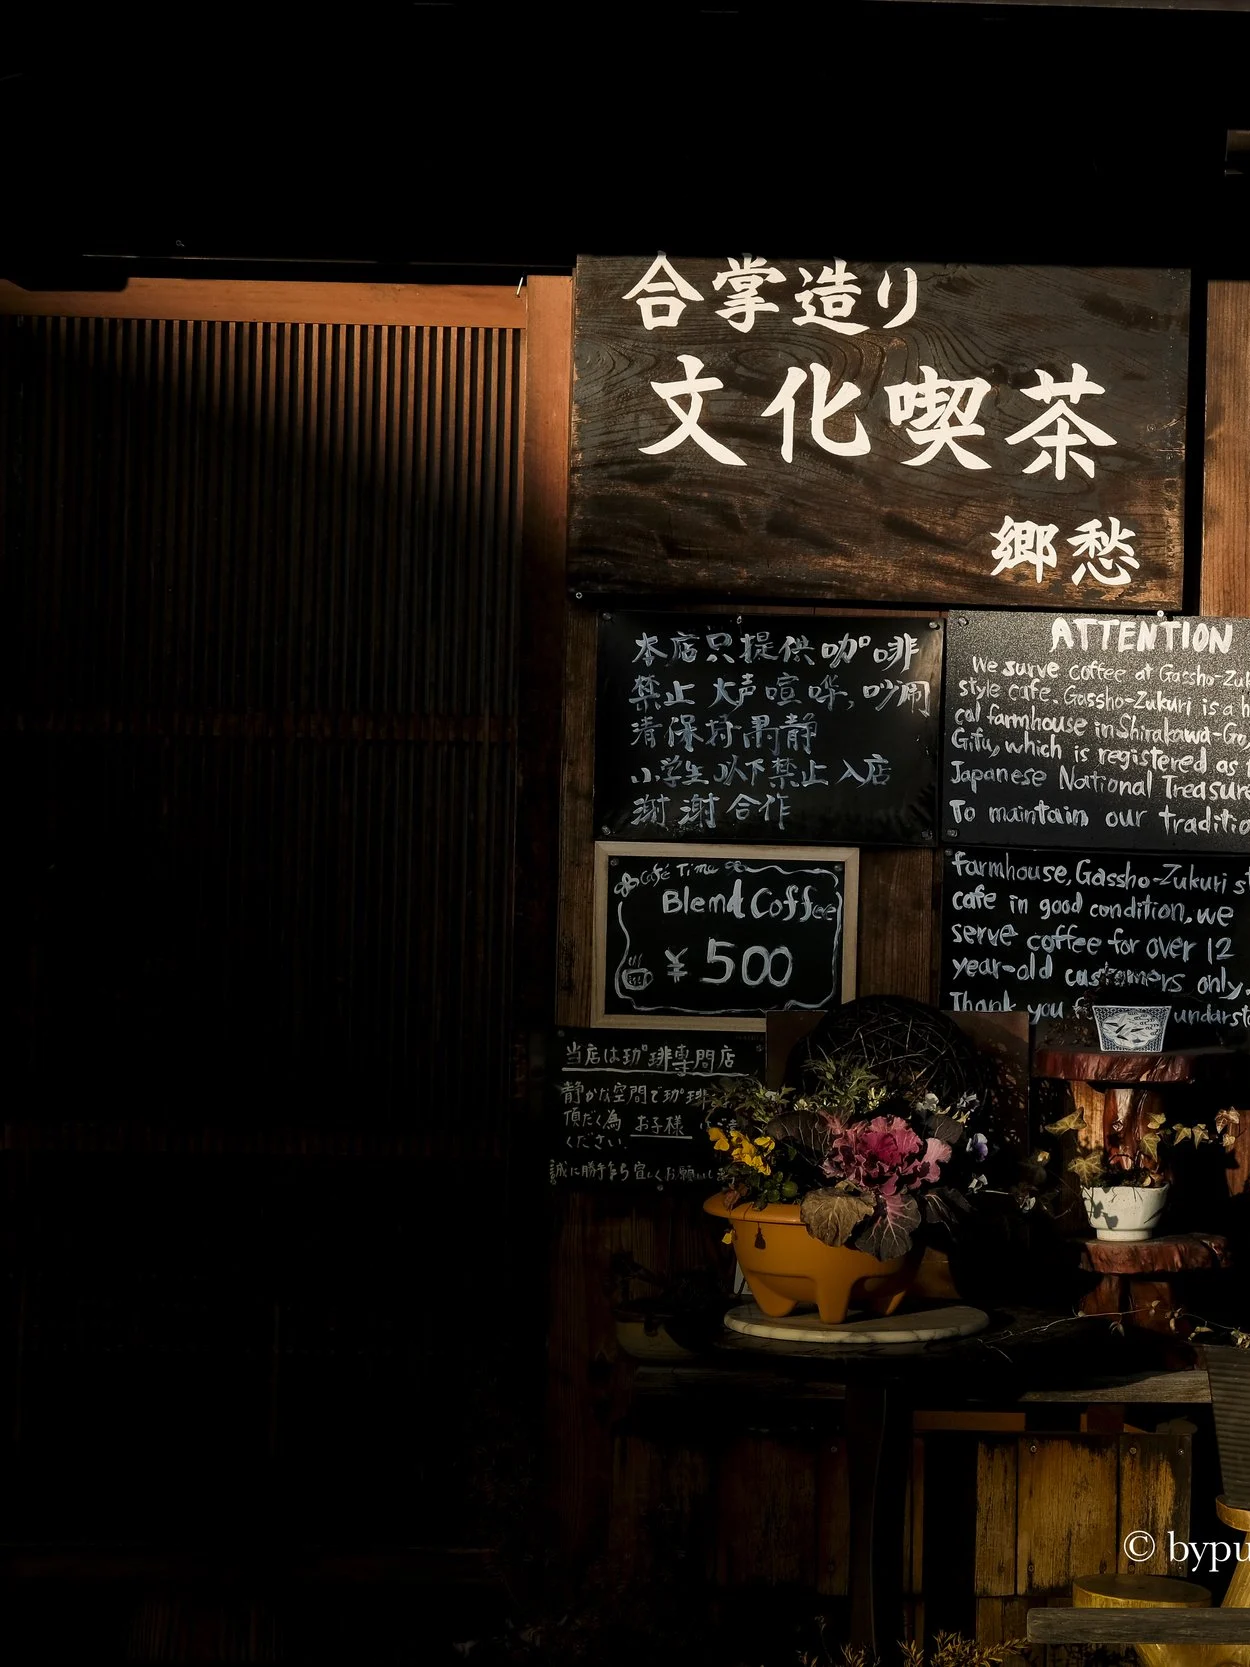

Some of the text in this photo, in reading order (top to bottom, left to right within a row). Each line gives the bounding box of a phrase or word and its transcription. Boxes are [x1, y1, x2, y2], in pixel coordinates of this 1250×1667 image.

[621, 250, 919, 335] 合掌造り
[638, 354, 1118, 481] 文化喫茶
[989, 514, 1140, 586] 郷愁
[1049, 617, 1233, 653] ATTENTION
[972, 656, 998, 674] We
[1069, 660, 1127, 681] coffee
[1135, 664, 1152, 680] at
[958, 677, 1000, 700] style
[1064, 685, 1191, 716] Gassho-Zukuri
[1201, 698, 1217, 717] is
[1222, 704, 1233, 717] a
[954, 702, 981, 726] cal
[986, 704, 1088, 736] farmhouse
[1005, 731, 1063, 760] which
[1074, 745, 1088, 763] is
[1098, 746, 1207, 775] registered
[1216, 758, 1238, 776] as
[950, 760, 1047, 793] Japanese
[1059, 765, 1153, 800] National
[949, 799, 976, 824] To
[989, 799, 1089, 828] maintain
[1105, 808, 1148, 828] our
[951, 850, 1072, 886] farmhouse,
[1076, 858, 1227, 894] Gassho-Zukuri
[662, 878, 837, 922] Blend Coffee
[952, 884, 997, 911] cafe
[1009, 894, 1028, 915] in
[1039, 891, 1083, 920] good
[1197, 905, 1234, 927] we
[951, 922, 1235, 965] serve coffee for over 12
[952, 954, 1053, 981] year-old
[1027, 1000, 1064, 1025] you
